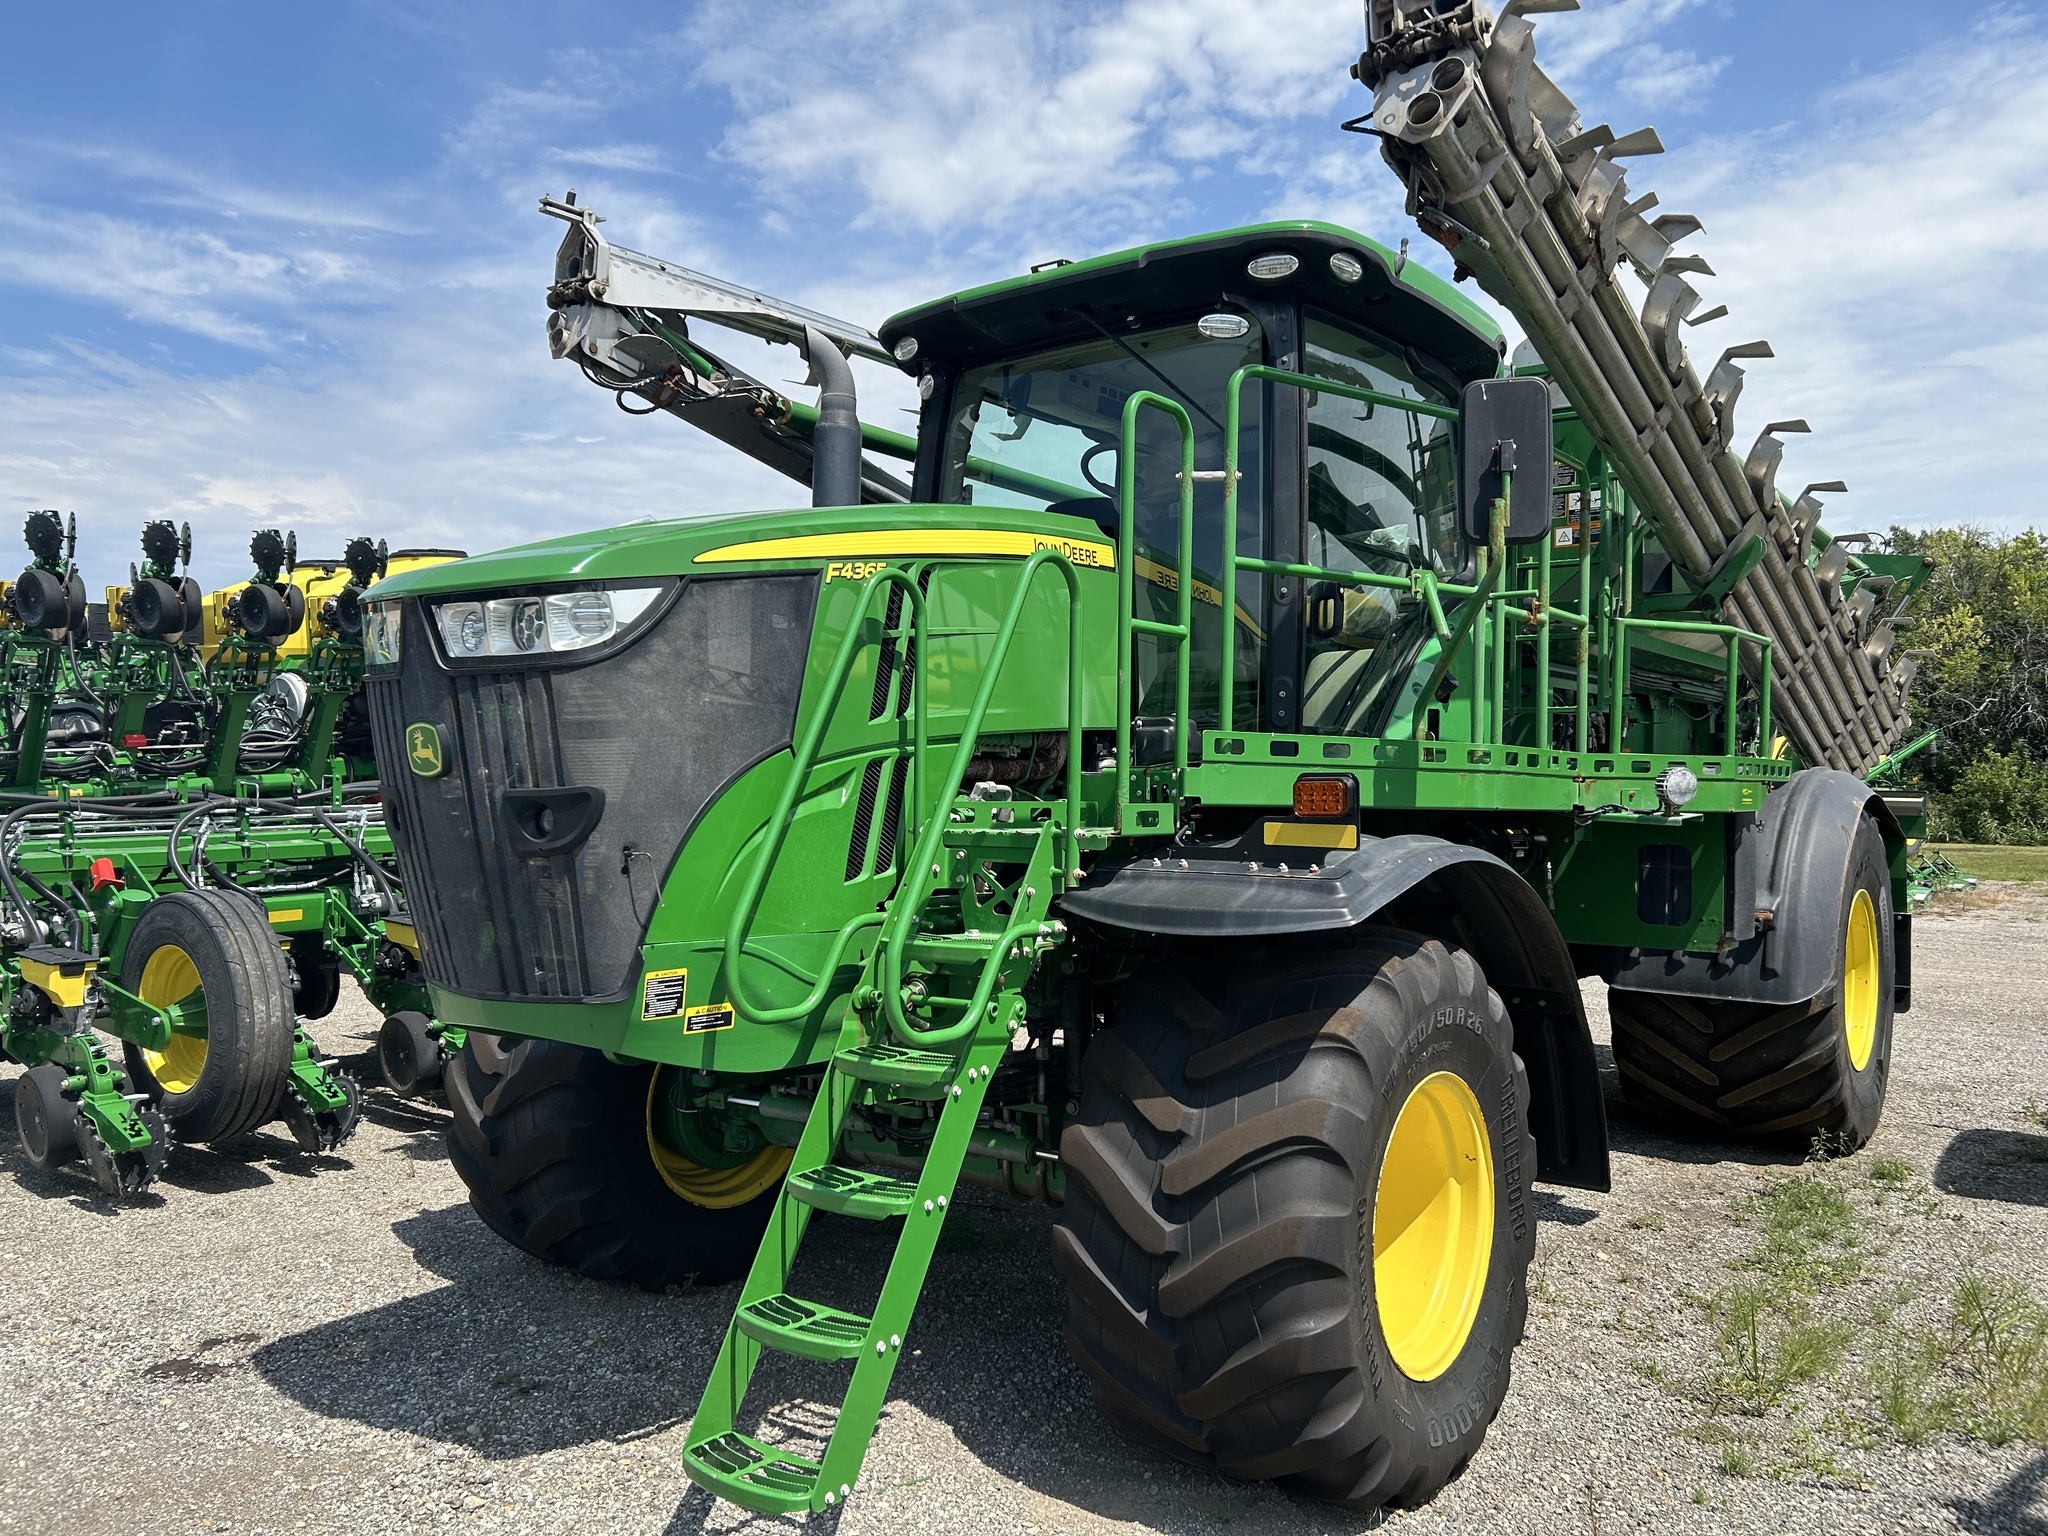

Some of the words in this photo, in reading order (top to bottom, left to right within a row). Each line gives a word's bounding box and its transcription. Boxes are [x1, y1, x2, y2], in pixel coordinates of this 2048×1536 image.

[1063, 542, 1099, 564] DEERE
[702, 1005, 727, 1014] CAUTION
[1400, 1006, 1454, 1065] 750/50
[1500, 1070, 1528, 1244] TRELLEBORG
